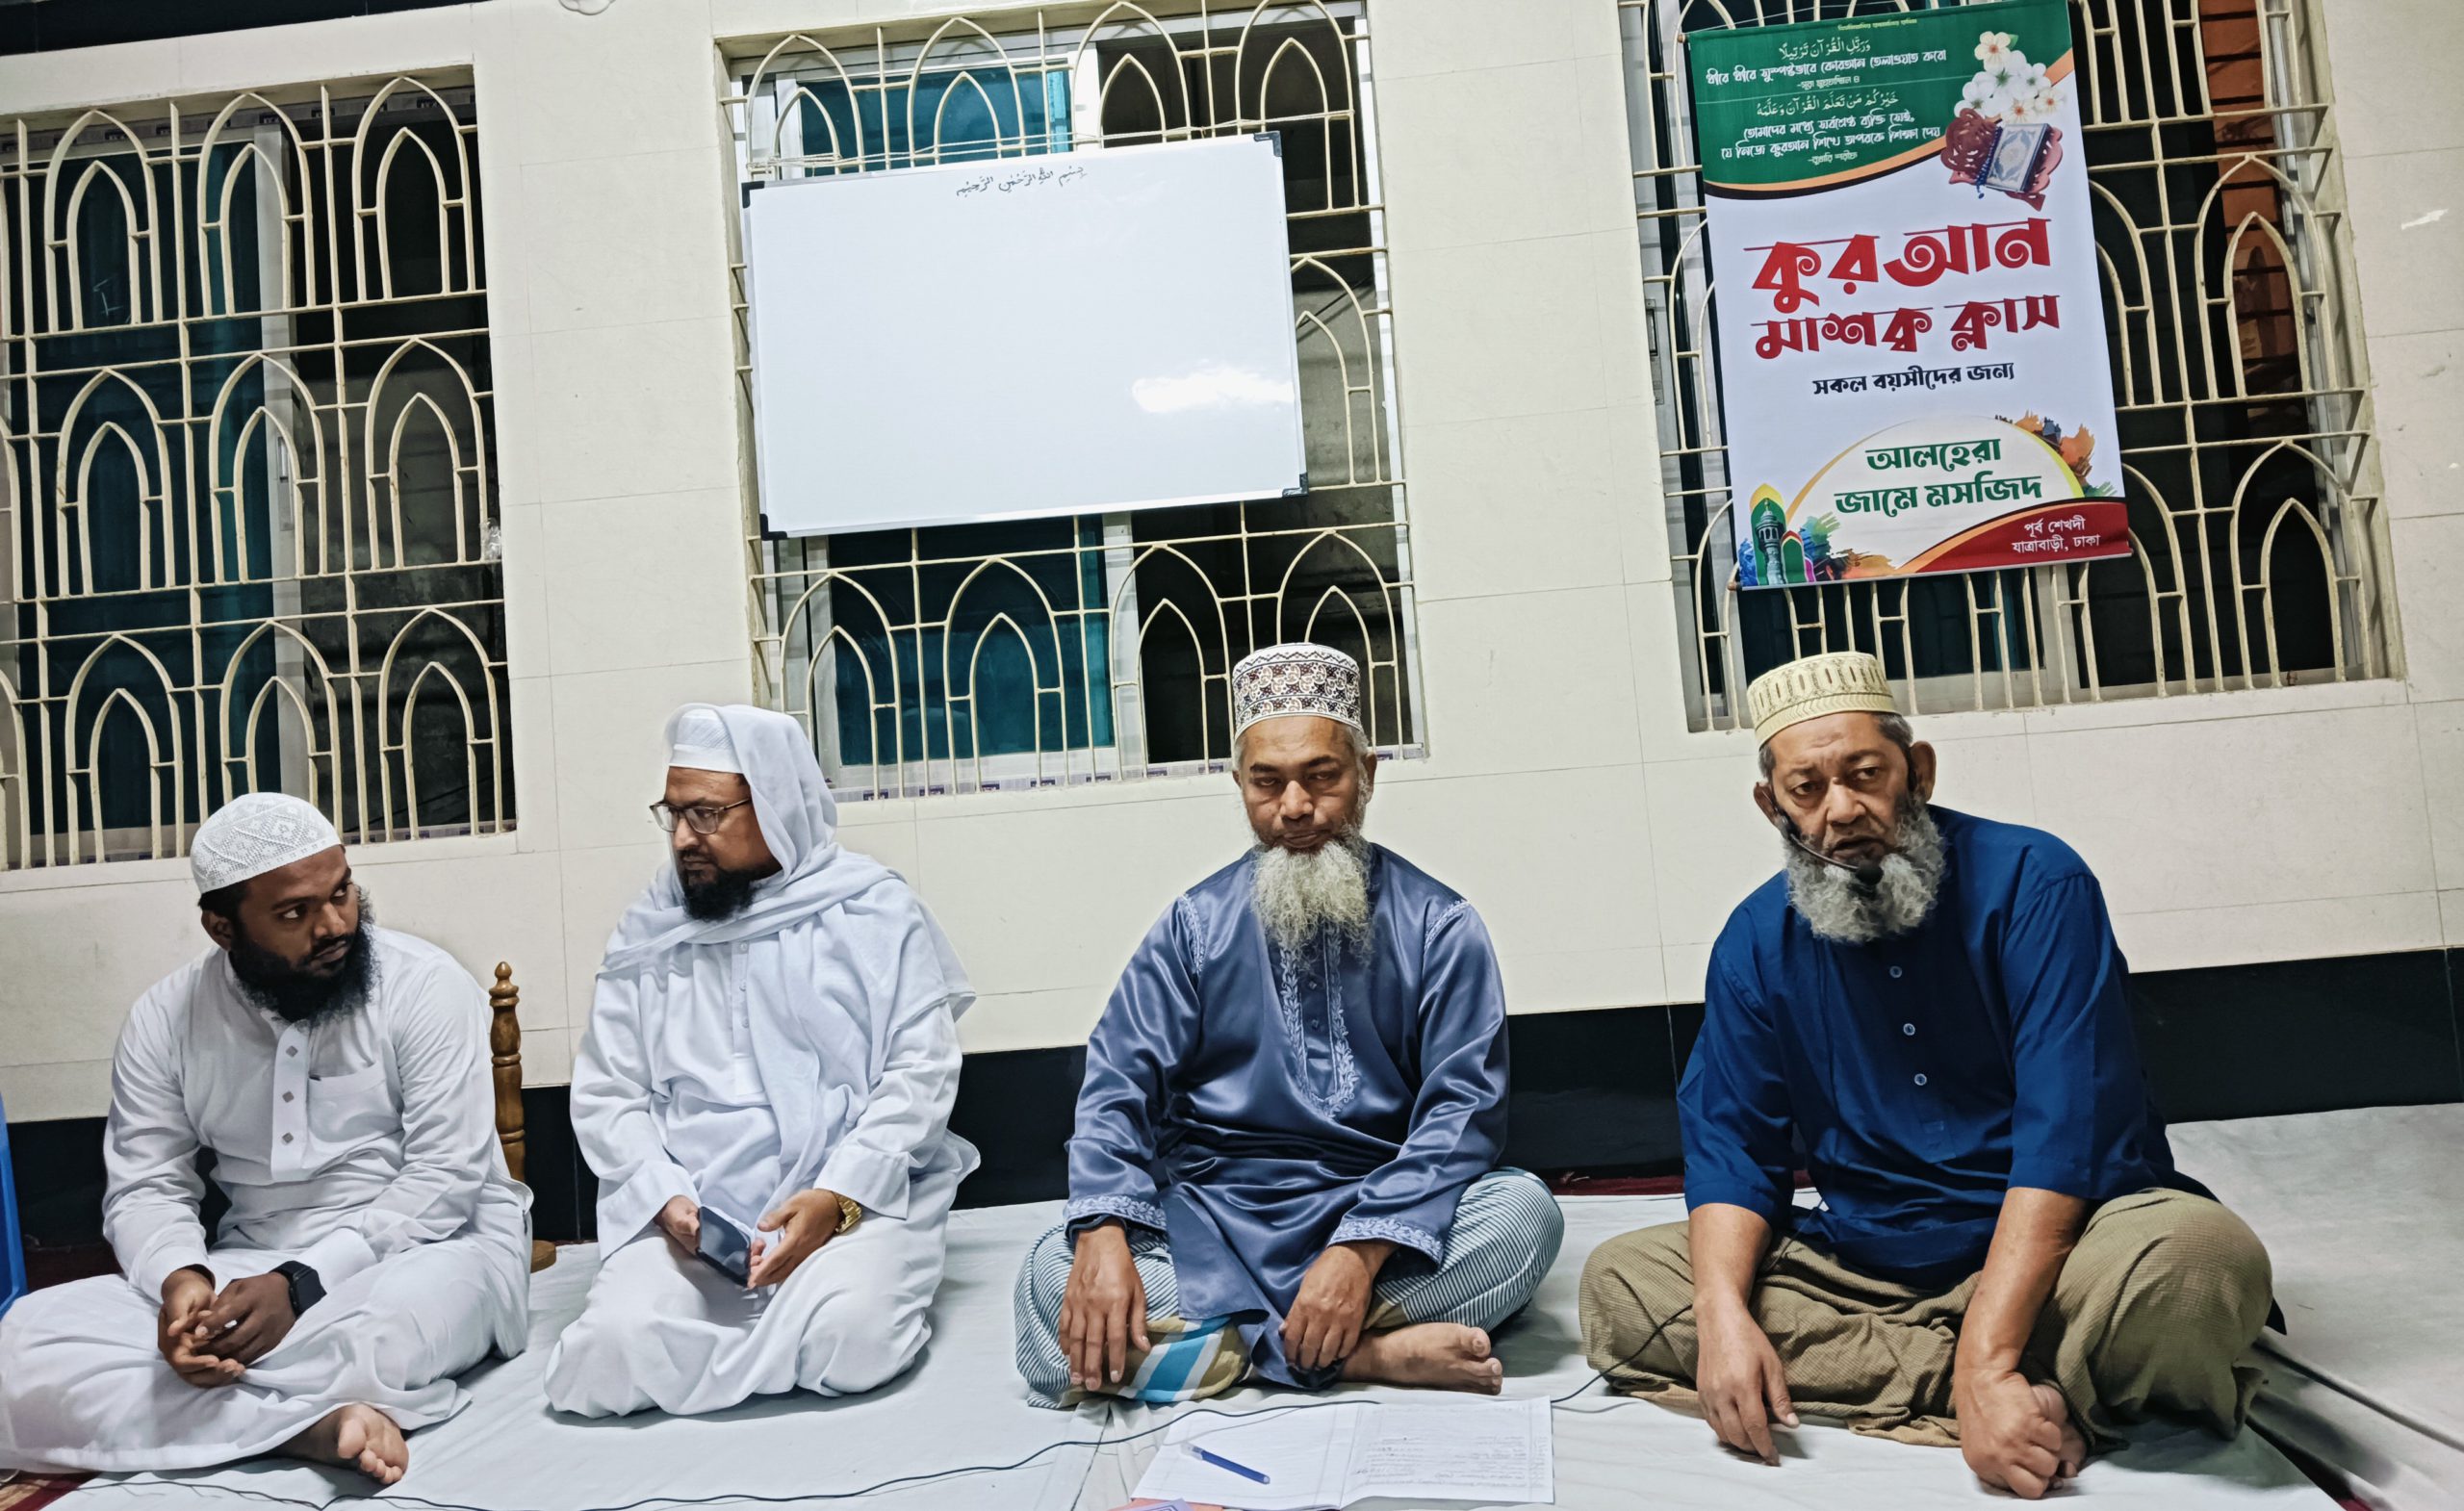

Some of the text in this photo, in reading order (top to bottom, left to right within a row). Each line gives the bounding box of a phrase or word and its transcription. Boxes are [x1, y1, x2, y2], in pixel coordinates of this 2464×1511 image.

[1744, 124, 1786, 141] তোমাদের
[1943, 295, 2061, 352] ক্লাস
[1813, 362, 2015, 396] সকল বয়সীদের জন্য
[1865, 438, 2001, 472] আলহেরা
[1834, 471, 2042, 518] জামে মসজিদ
[2012, 533, 2100, 553] যাত্রাবাড়ী, ঢাকা
[2024, 514, 2087, 538] পূর্ব শেখদী
